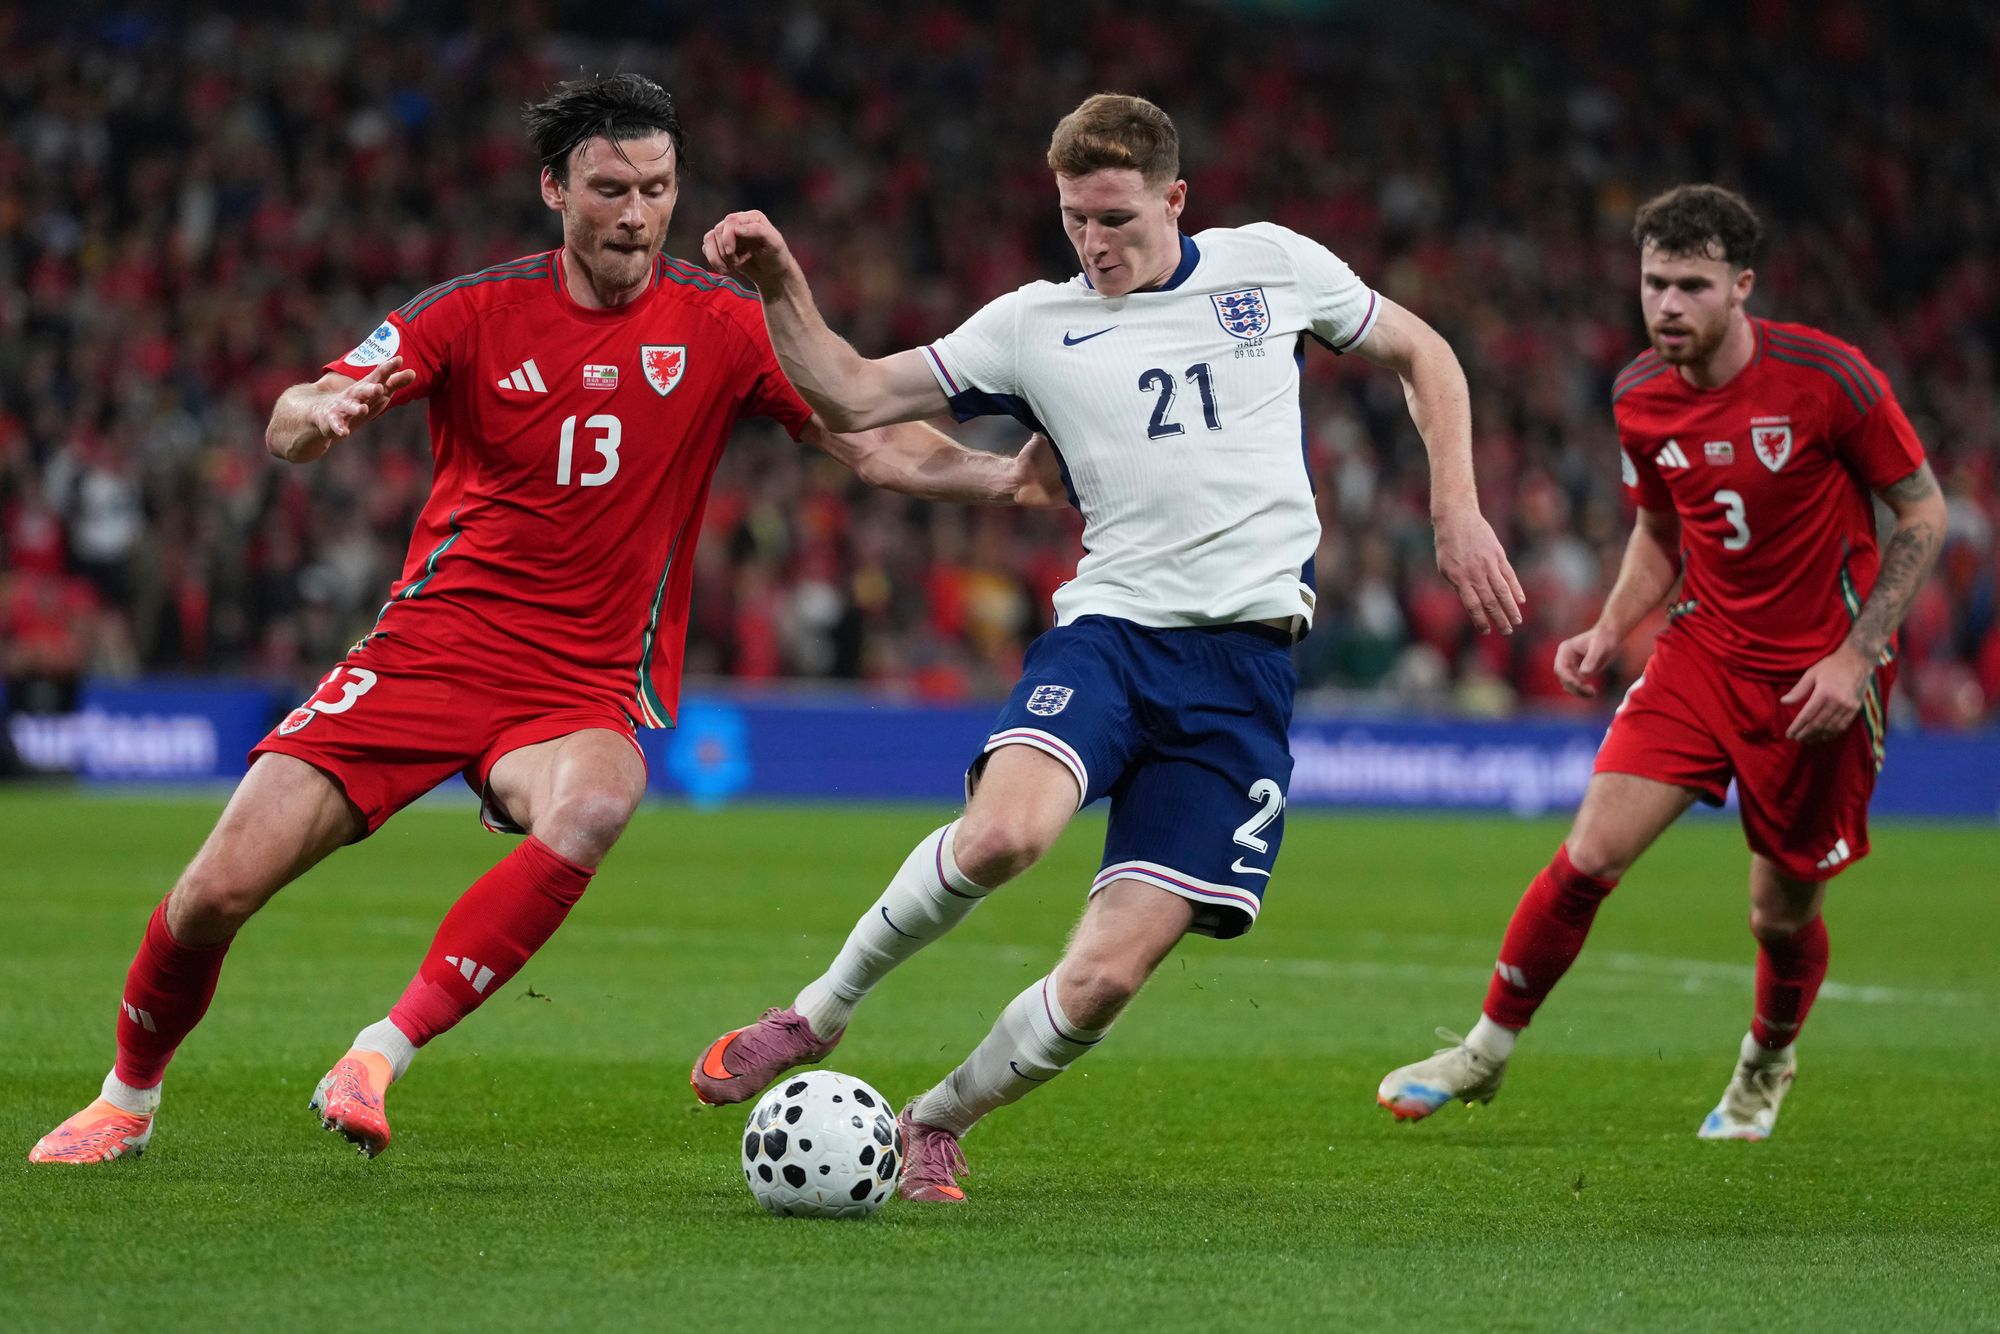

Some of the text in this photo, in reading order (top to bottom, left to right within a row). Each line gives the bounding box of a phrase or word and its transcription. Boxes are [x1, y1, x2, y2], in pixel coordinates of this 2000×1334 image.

[1234, 348, 1266, 359] 09.10.25
[1138, 362, 1222, 440] 21
[556, 414, 622, 487] 13
[1713, 489, 1751, 550] 3
[1232, 778, 1287, 854] 2
